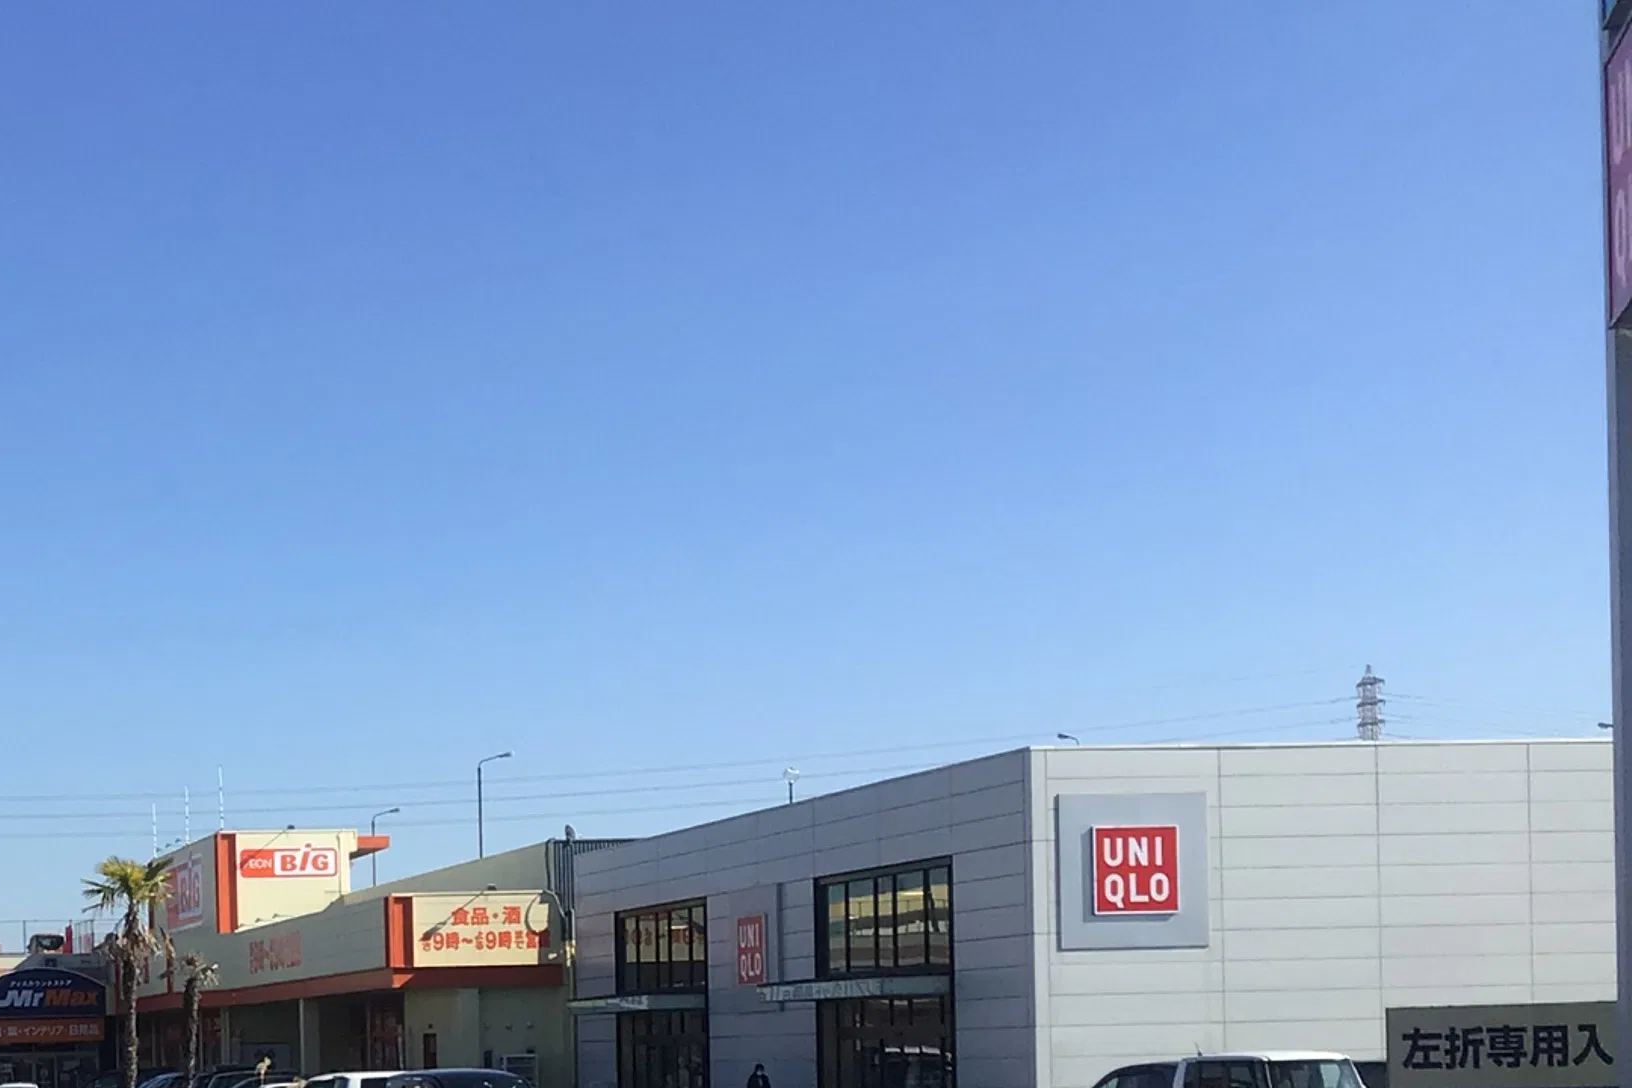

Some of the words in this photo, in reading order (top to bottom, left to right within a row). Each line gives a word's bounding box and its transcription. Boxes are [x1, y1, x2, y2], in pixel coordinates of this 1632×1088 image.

[1103, 836, 1163, 867] UNI
[1104, 872, 1170, 909] QLO
[451, 906, 521, 926] 食品・酒
[739, 923, 760, 949] UNI
[740, 952, 762, 981] QLO
